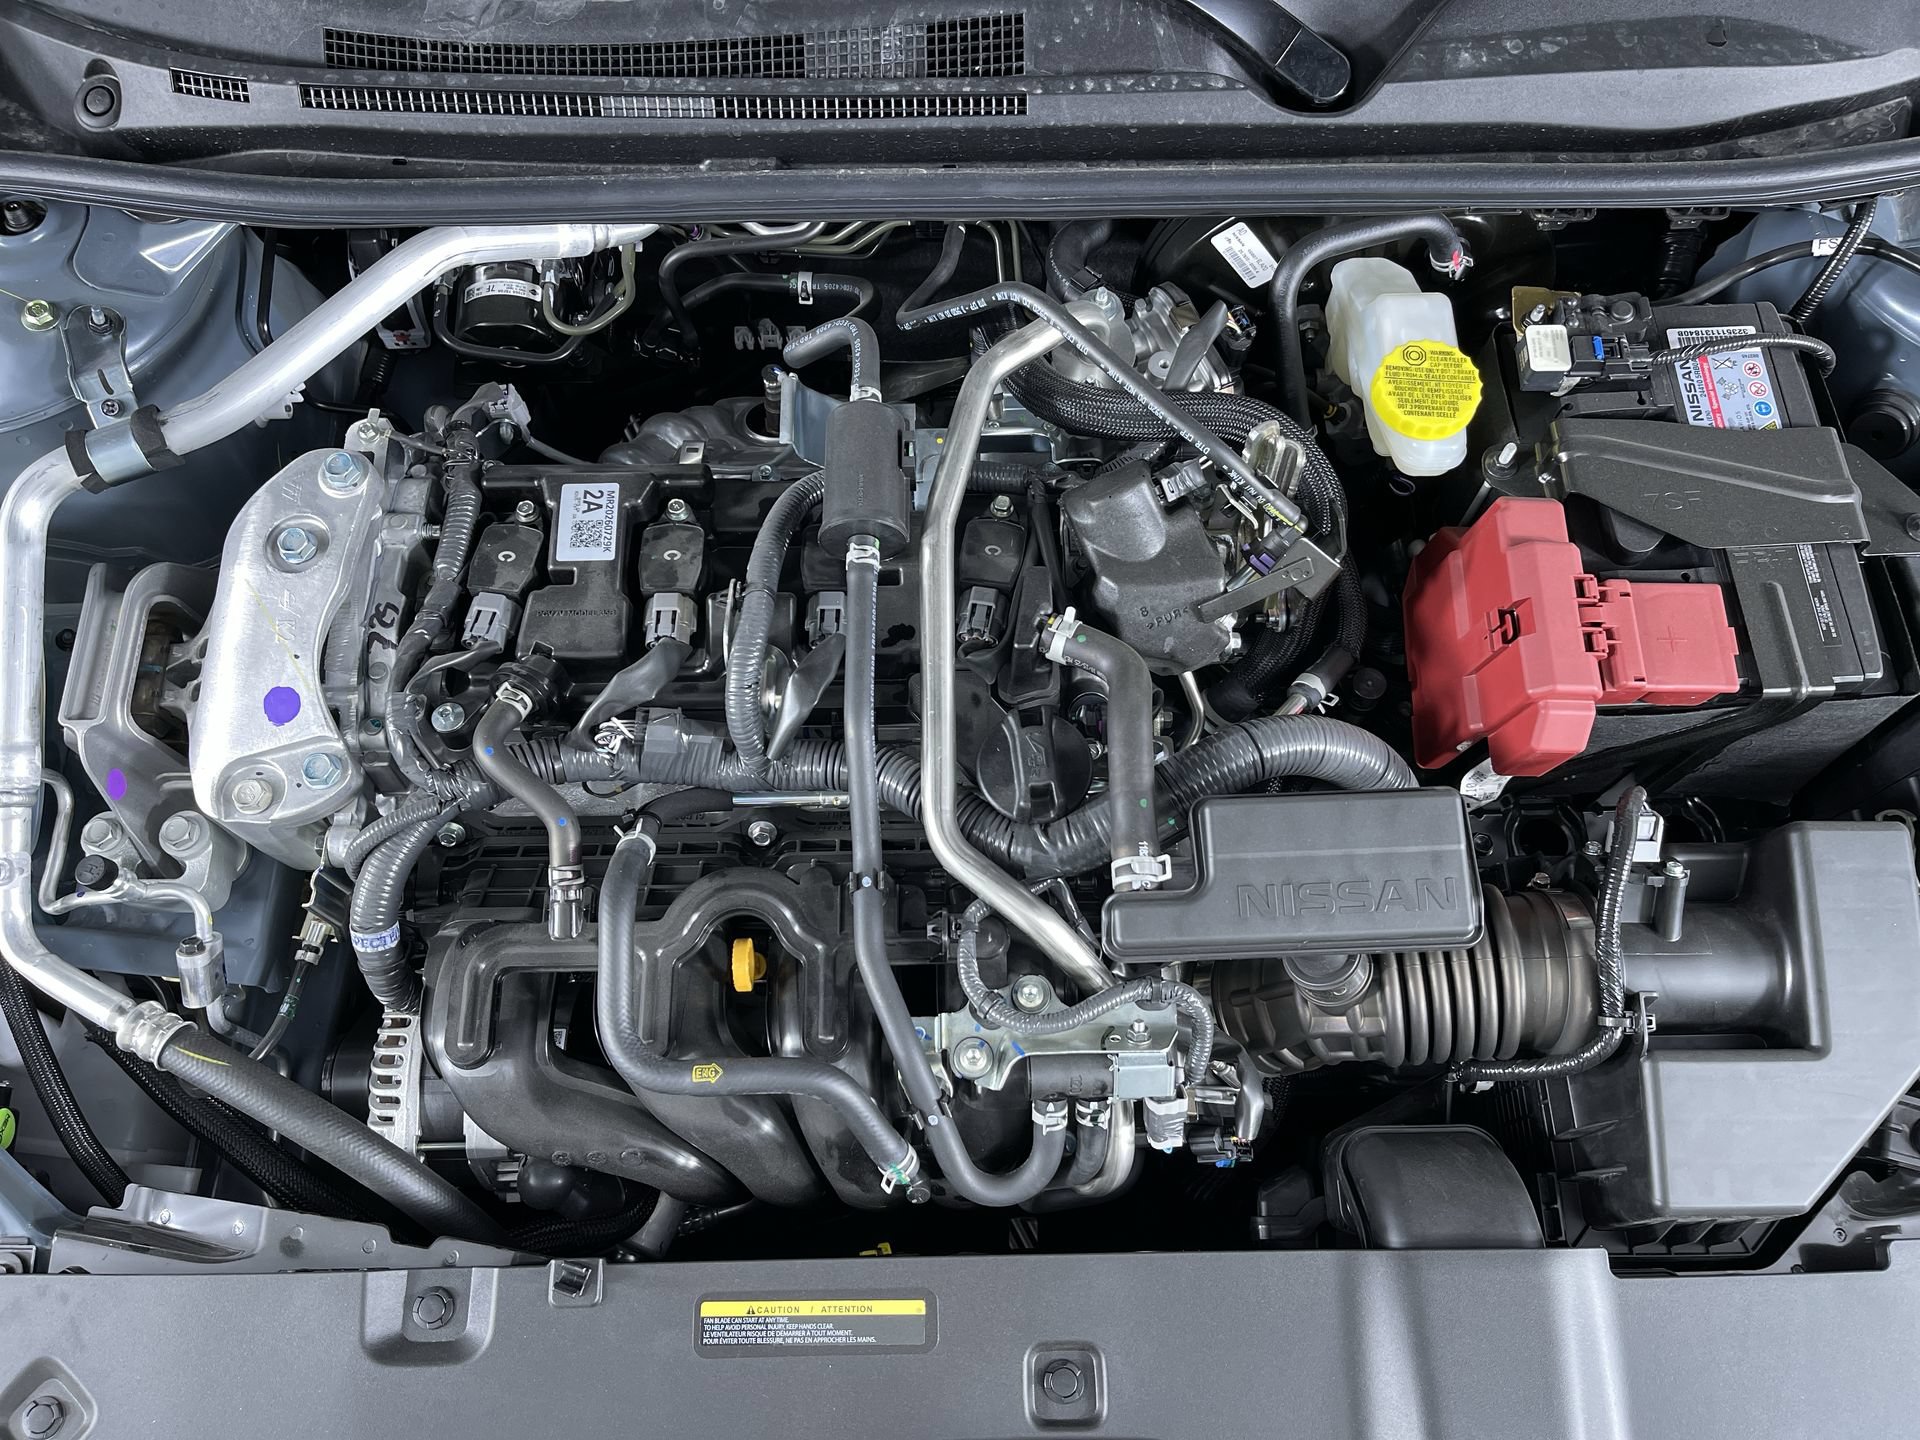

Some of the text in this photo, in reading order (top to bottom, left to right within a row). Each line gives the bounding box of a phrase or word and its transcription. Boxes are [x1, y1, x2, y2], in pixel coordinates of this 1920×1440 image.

[1818, 238, 1838, 249] FS
[485, 283, 495, 292] 7F
[1105, 367, 1123, 384] KINK
[1122, 382, 1137, 396] NOT
[1679, 360, 1704, 422] NISSAN
[1397, 396, 1429, 404] SEULEMENT
[1146, 401, 1165, 419] 5920
[1403, 409, 1435, 417] CONTENANT
[1179, 428, 1194, 442] CFP
[1194, 439, 1210, 455] DTR
[1227, 468, 1245, 486] KINK
[582, 490, 604, 514] 2A
[603, 490, 615, 553] MR20260729K
[1236, 877, 1458, 917] NISSAN
[695, 1067, 715, 1078] ENG
[757, 1305, 873, 1314] CAUTION / ATTENTION
